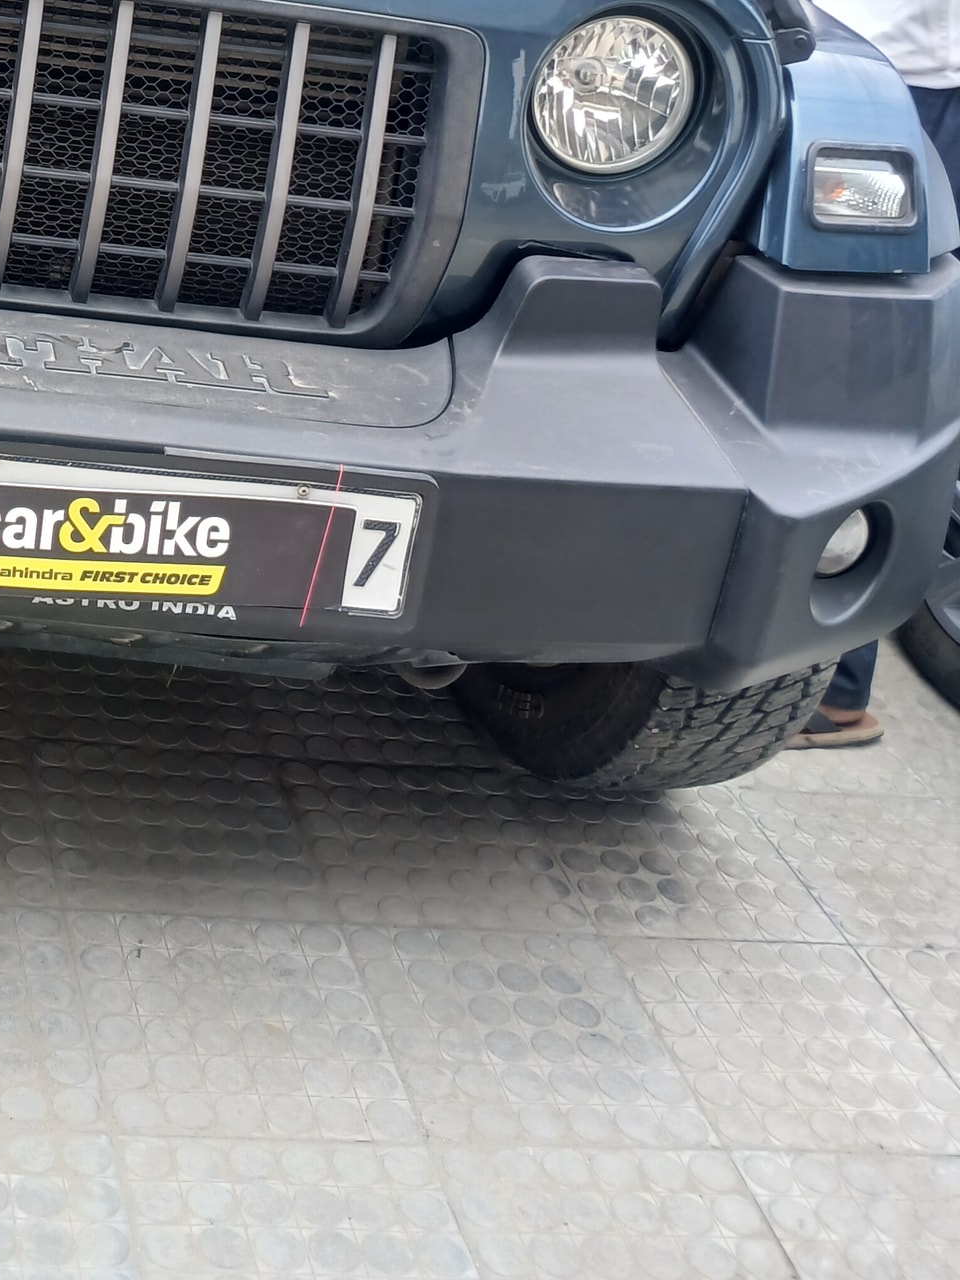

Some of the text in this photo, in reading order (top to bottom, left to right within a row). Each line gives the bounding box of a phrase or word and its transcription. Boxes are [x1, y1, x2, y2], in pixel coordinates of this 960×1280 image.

[353, 518, 401, 588] 7
[79, 569, 140, 584] FIRST
[139, 572, 213, 587] CHOICE
